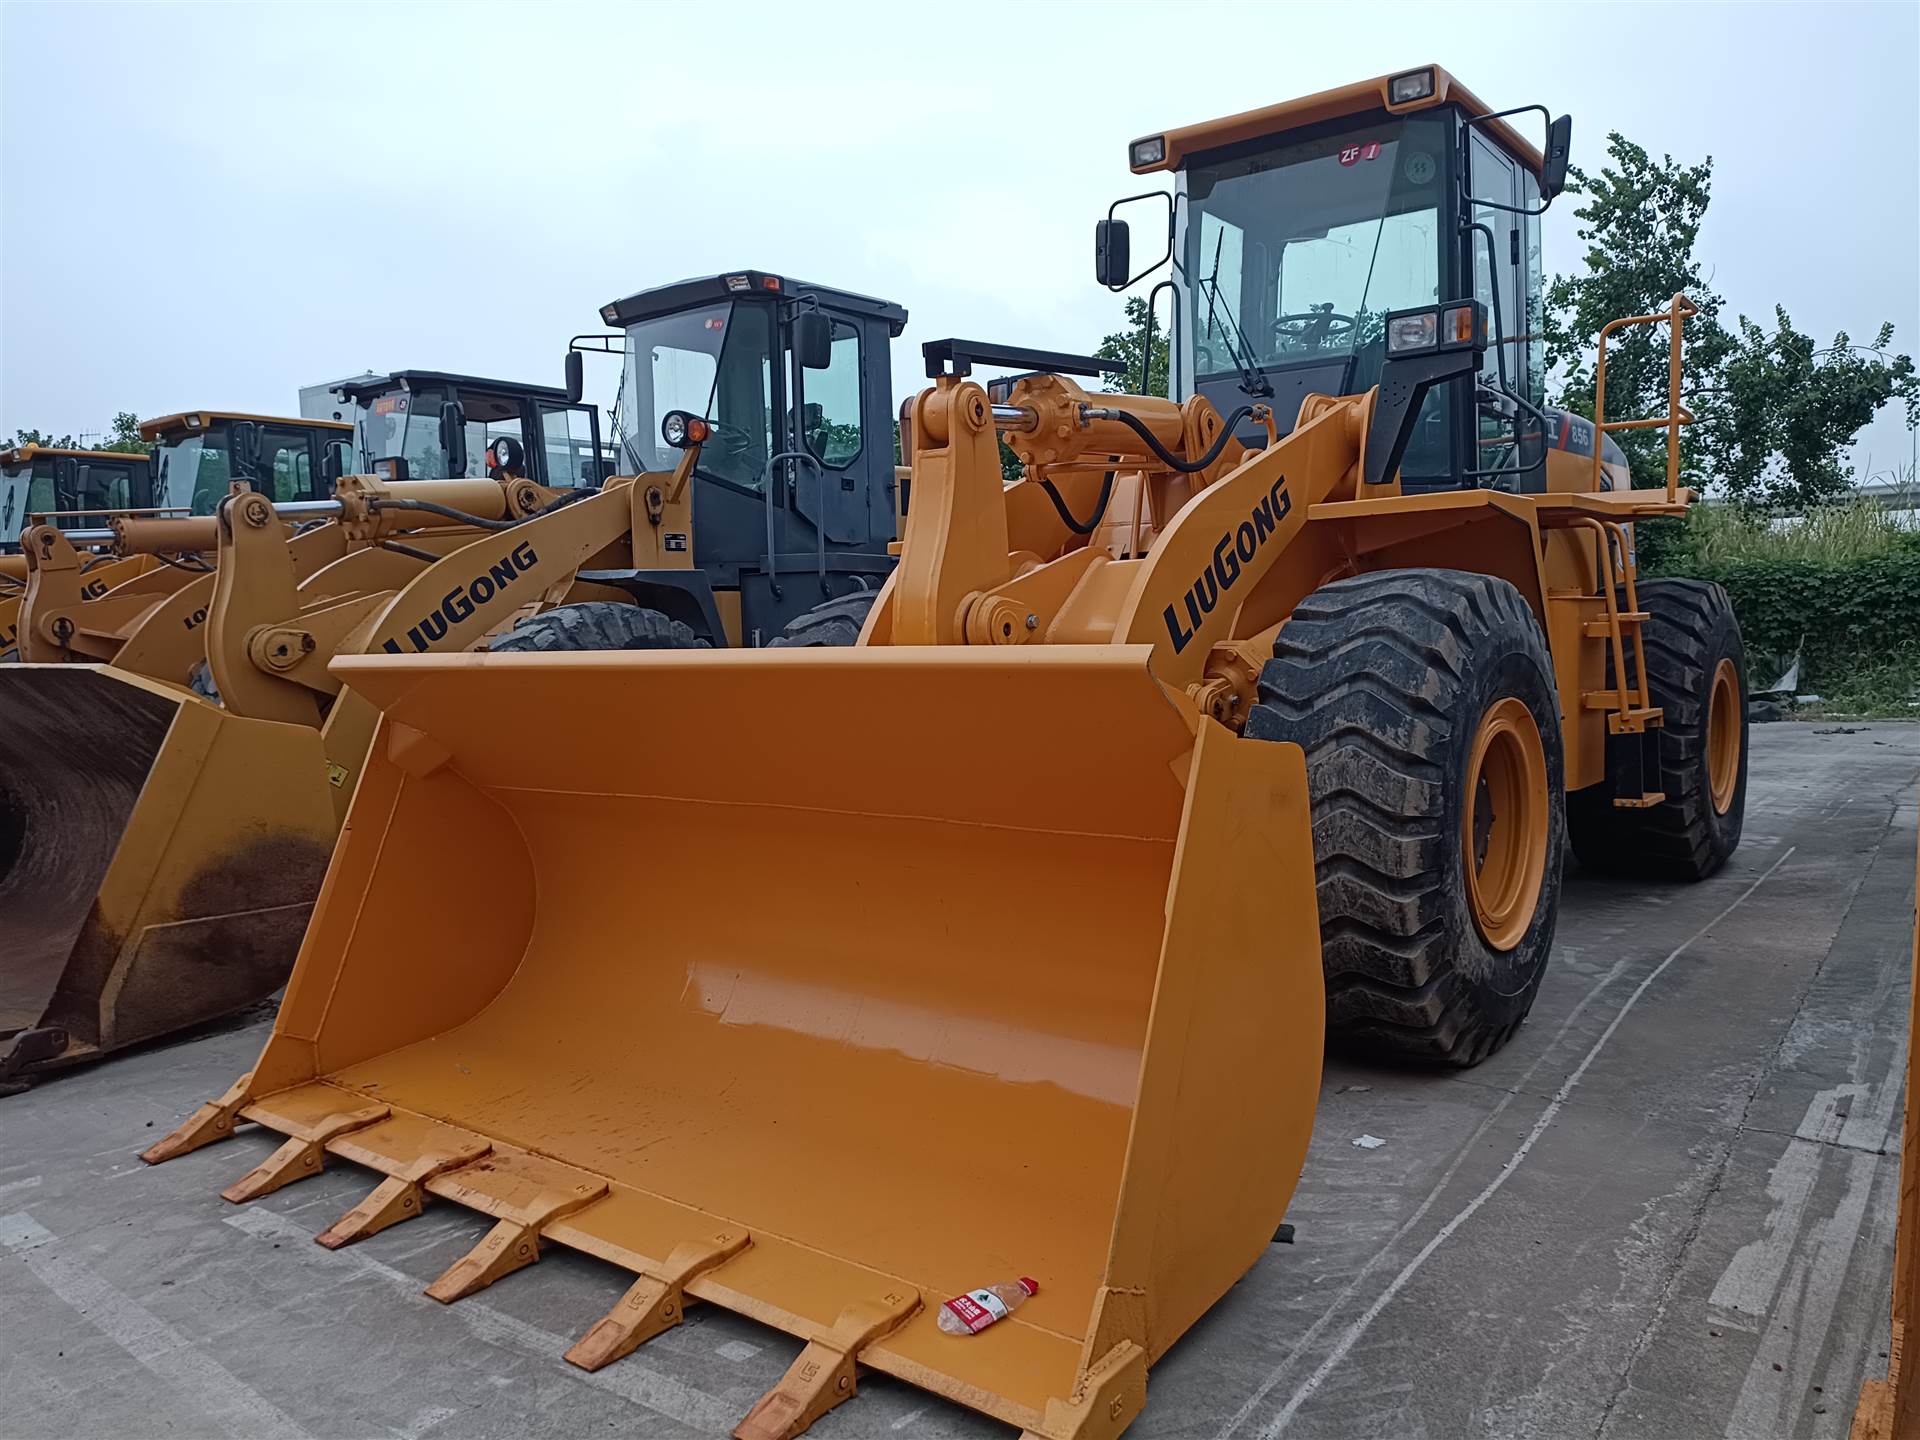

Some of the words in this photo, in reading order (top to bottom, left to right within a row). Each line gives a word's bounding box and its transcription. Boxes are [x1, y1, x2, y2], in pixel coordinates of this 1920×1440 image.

[1341, 147, 1360, 163] ZF
[1571, 426, 1589, 446] 856
[382, 540, 538, 654] LIUGONG
[1163, 474, 1292, 655] LIUGONG
